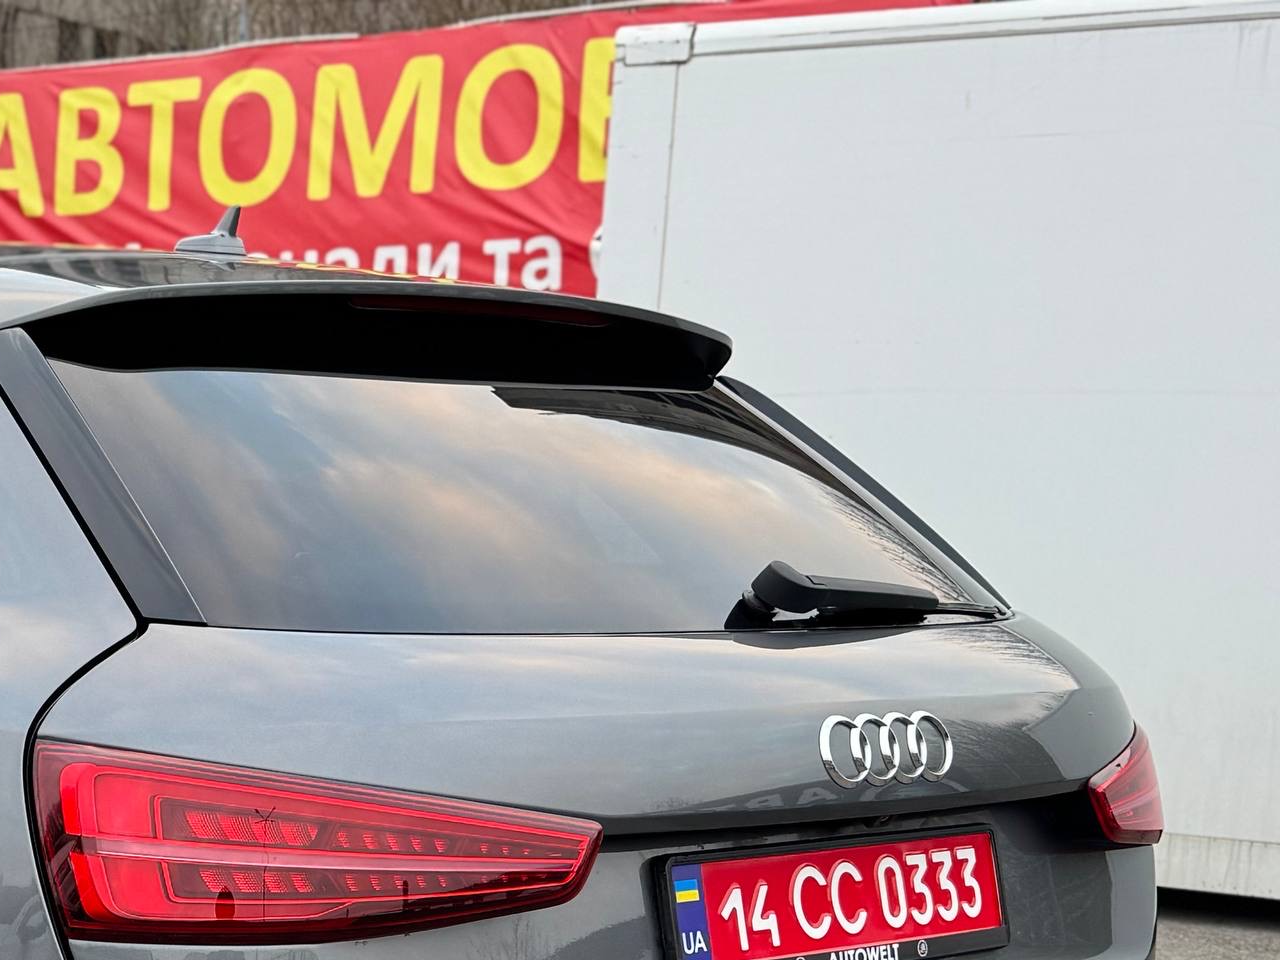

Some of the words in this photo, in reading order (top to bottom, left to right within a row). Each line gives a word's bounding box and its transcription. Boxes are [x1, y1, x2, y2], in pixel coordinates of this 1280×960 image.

[482, 234, 563, 291] та
[719, 883, 781, 952] 14
[792, 860, 868, 940] CC
[876, 845, 983, 929] 0333
[682, 930, 708, 955] UA
